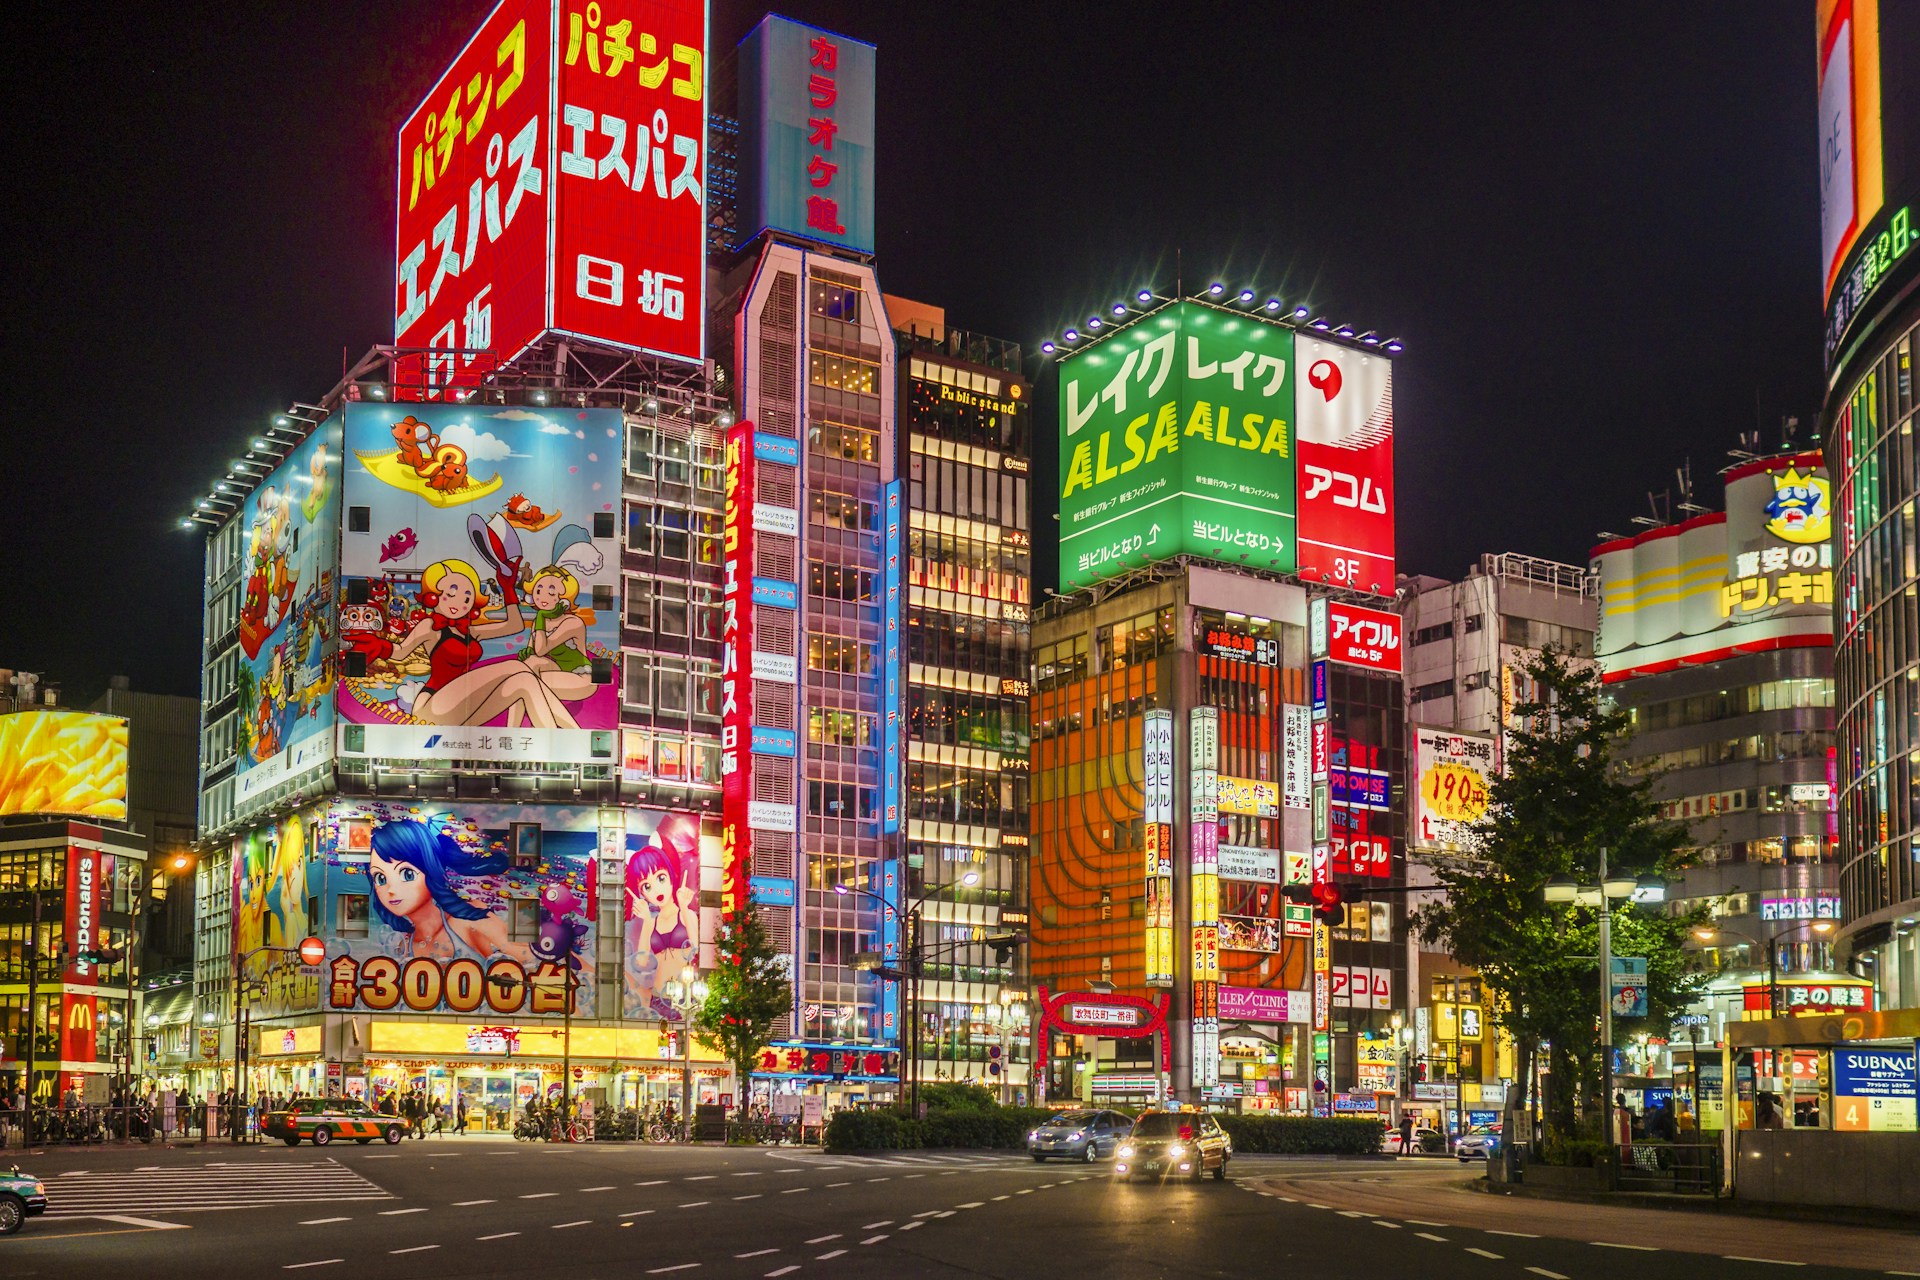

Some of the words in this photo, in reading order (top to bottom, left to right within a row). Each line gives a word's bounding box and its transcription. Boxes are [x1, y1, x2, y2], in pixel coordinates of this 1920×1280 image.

[566, 1, 702, 101] パチンコ
[409, 18, 525, 212] パチンコ
[561, 104, 702, 206] エスパス
[397, 114, 542, 340] エスパス
[576, 253, 684, 321] 日拓
[428, 283, 492, 399] 日拓
[1067, 331, 1176, 437] レイク
[1187, 336, 1286, 397] レイク
[941, 385, 977, 407] Public
[979, 397, 1017, 416] stand
[1184, 400, 1289, 459] ALSA
[1062, 400, 1179, 499] ALSA
[725, 438, 741, 553] パチンコ
[1304, 464, 1387, 515] アコム
[1078, 535, 1143, 572] 当ビルとなり
[1192, 519, 1270, 550] 当ビルとなり
[1334, 558, 1360, 581] 3F
[722, 559, 739, 718] エスパス
[1331, 614, 1399, 649] アイフル
[1369, 650, 1382, 662] 5F
[478, 735, 534, 751] 北電子
[1316, 734, 1325, 772] アイフル
[1147, 730, 1156, 808] 小松ビル
[1159, 729, 1170, 808] 小松ビル
[1332, 774, 1385, 794] PROMISE
[722, 823, 736, 914] パチンコ
[1331, 837, 1388, 864] アイフル
[1354, 863, 1365, 873] 5F
[1317, 961, 1327, 969] 2F
[1333, 973, 1389, 996] アコム
[1335, 998, 1344, 1006] 3F
[804, 1003, 854, 1022] ダーツ
[1074, 1009, 1135, 1022] 歌舞伎町一番街
[1846, 1104, 1859, 1126] 4
